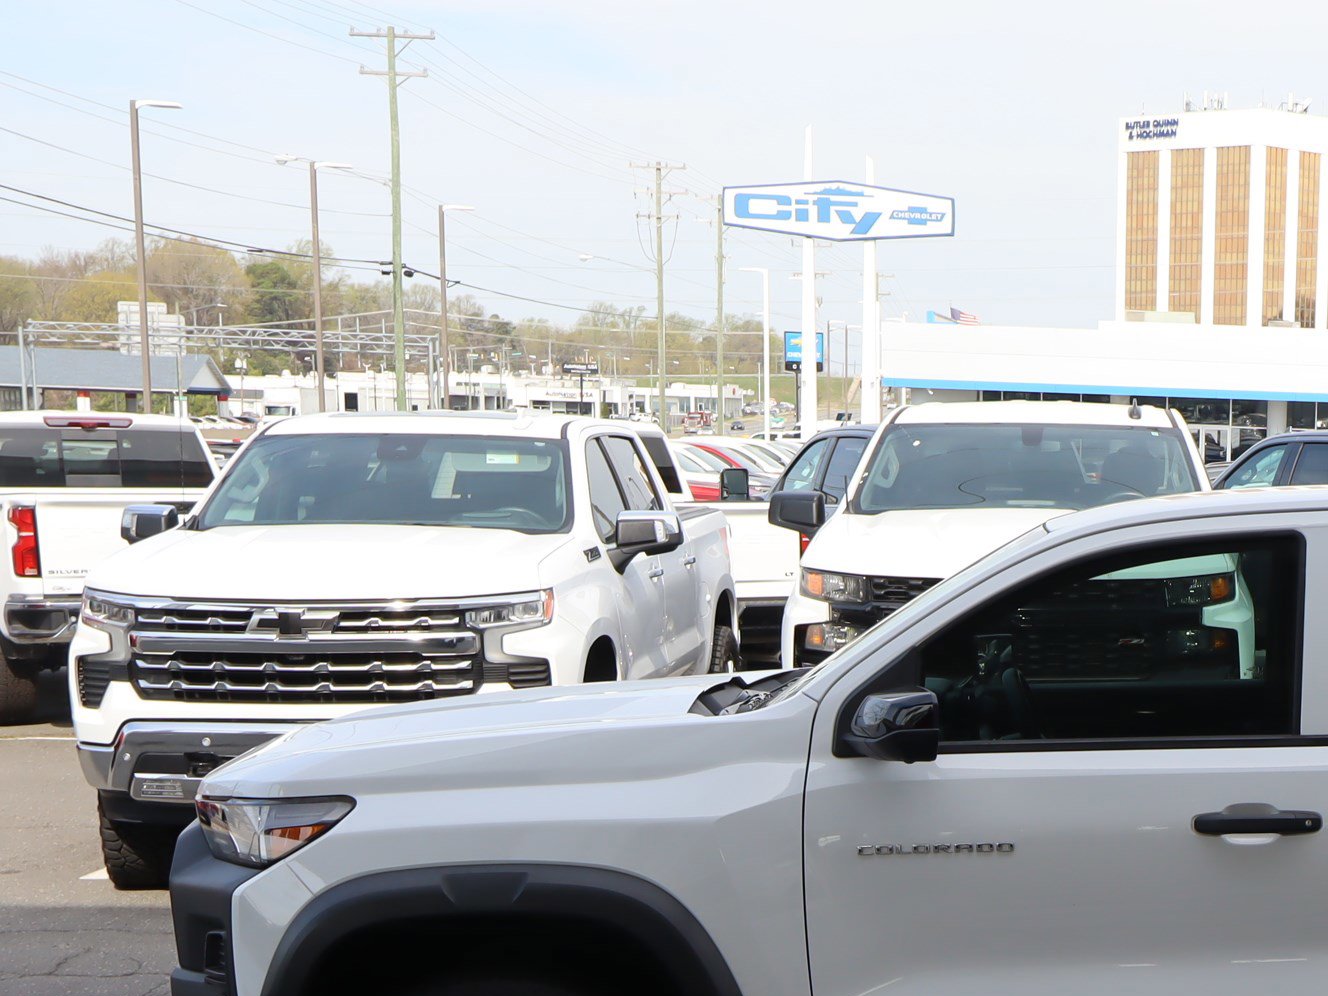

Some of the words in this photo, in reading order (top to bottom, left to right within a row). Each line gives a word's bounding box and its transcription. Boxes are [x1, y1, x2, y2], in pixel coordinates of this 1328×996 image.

[1125, 121, 1150, 130] BUTLER
[1152, 118, 1179, 129] QUINN
[1136, 129, 1177, 139] HOCHMAN
[734, 193, 882, 235] City
[893, 211, 943, 221] CHEVROLET
[857, 843, 1015, 856] COLORADO
